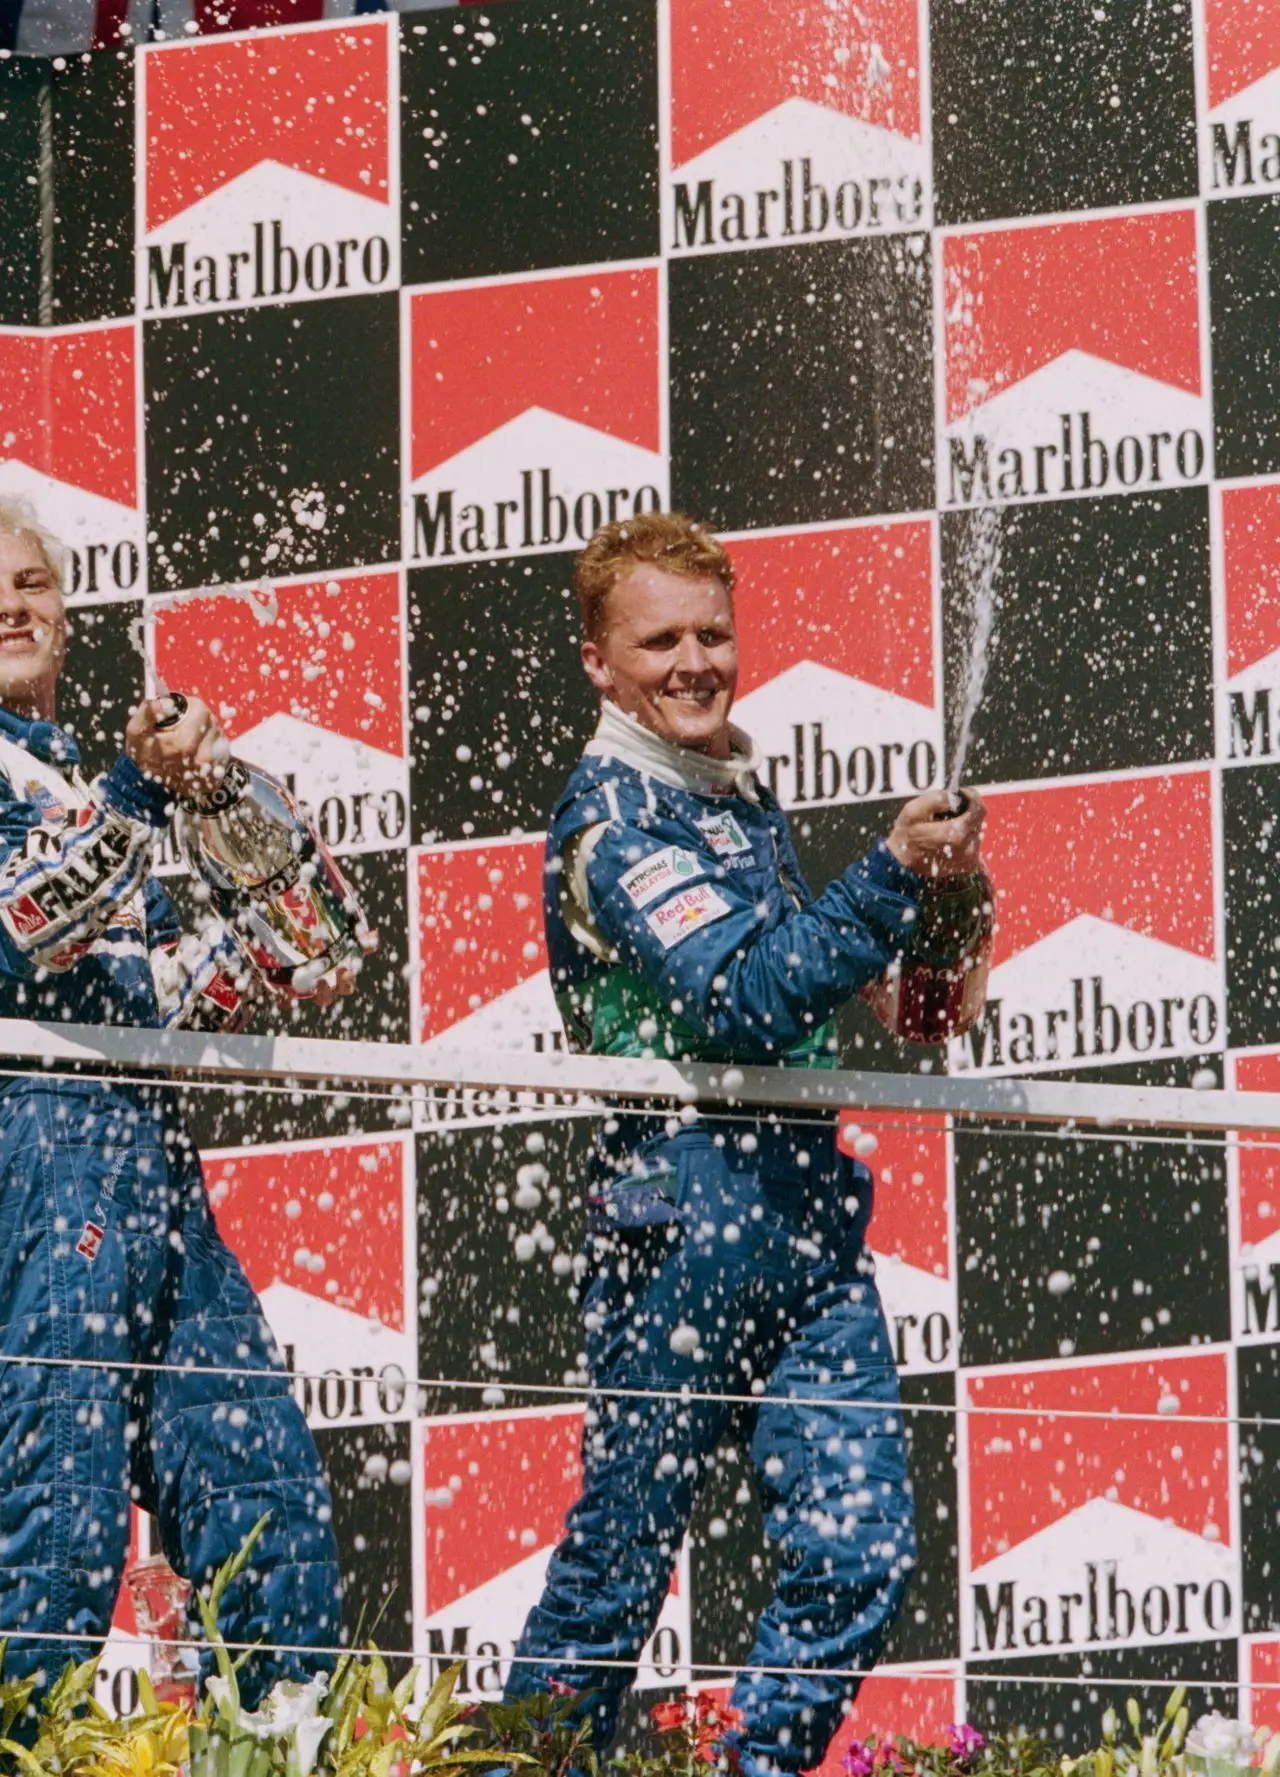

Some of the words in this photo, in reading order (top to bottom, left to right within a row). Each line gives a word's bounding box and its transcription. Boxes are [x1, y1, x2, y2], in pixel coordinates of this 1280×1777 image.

[671, 157, 923, 249] Marlboro
[145, 220, 390, 311] Marlboro
[948, 411, 1205, 504] Marlboro
[764, 722, 937, 803] rlboro
[626, 859, 669, 891] PETRONAS
[655, 895, 685, 925] Red
[683, 886, 712, 906] Bull
[969, 1560, 1233, 1653] Marlboro
